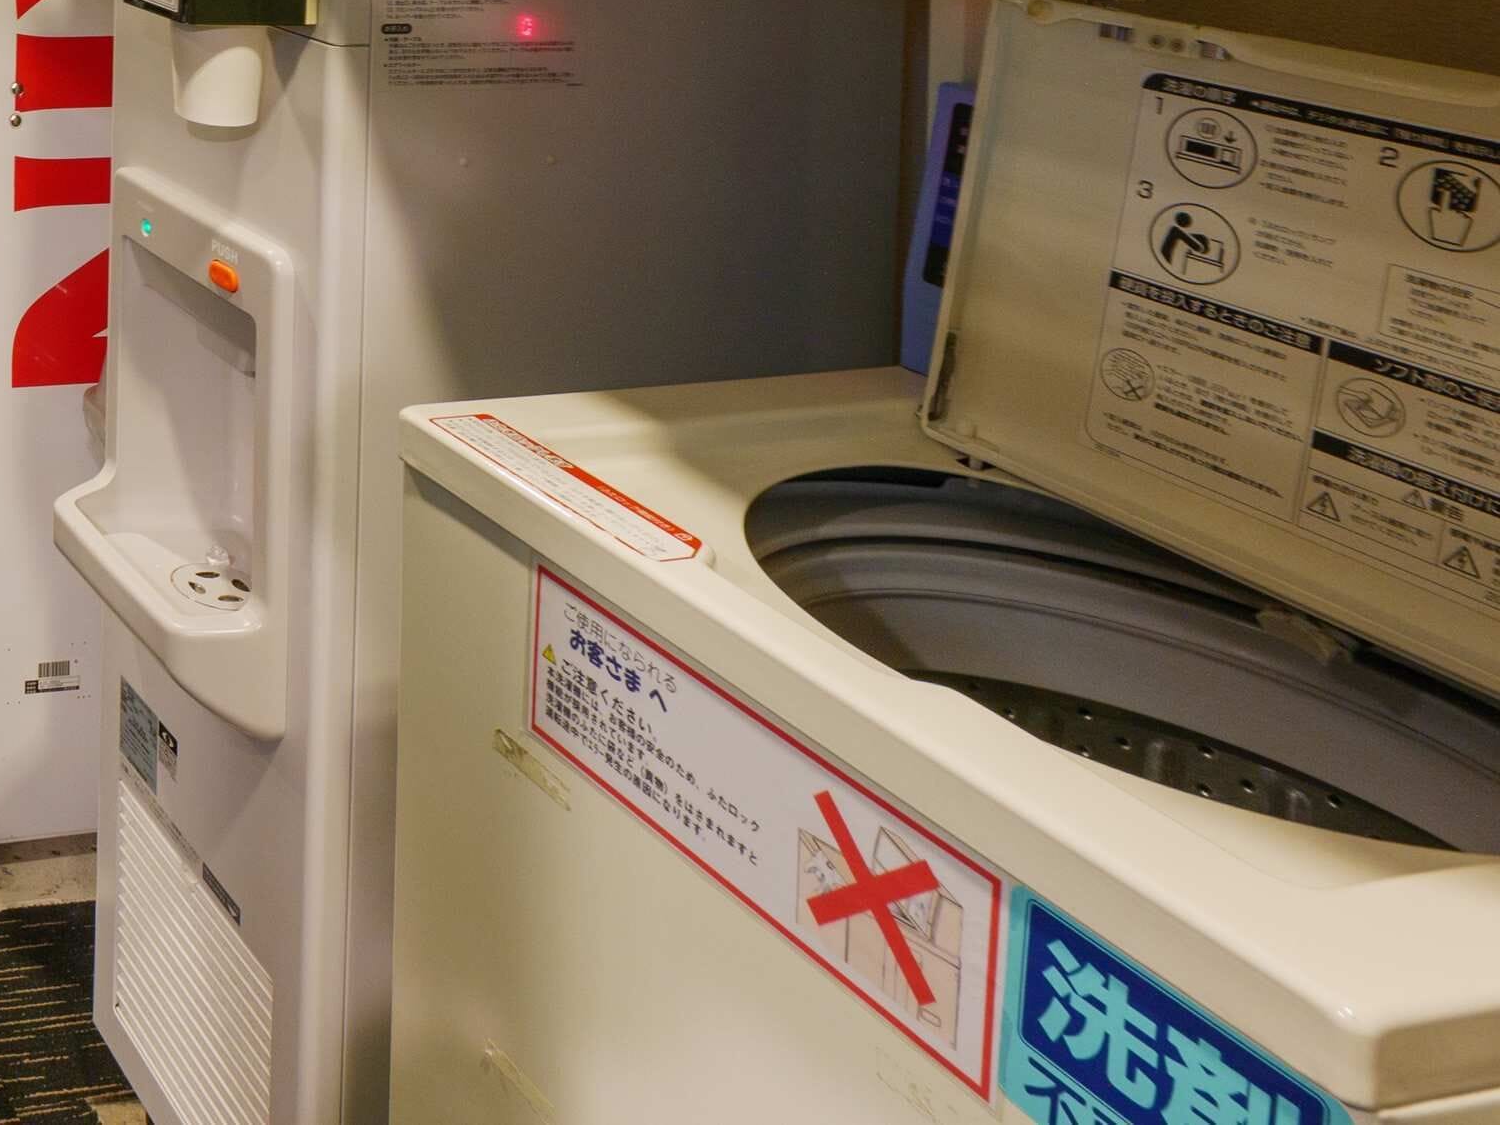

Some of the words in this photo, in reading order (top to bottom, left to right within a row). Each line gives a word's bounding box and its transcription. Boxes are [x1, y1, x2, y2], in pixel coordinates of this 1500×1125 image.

[1379, 146, 1399, 168] 2
[1137, 180, 1154, 200] 3
[211, 239, 239, 265] PUSH
[564, 602, 676, 694] ご使用になられる
